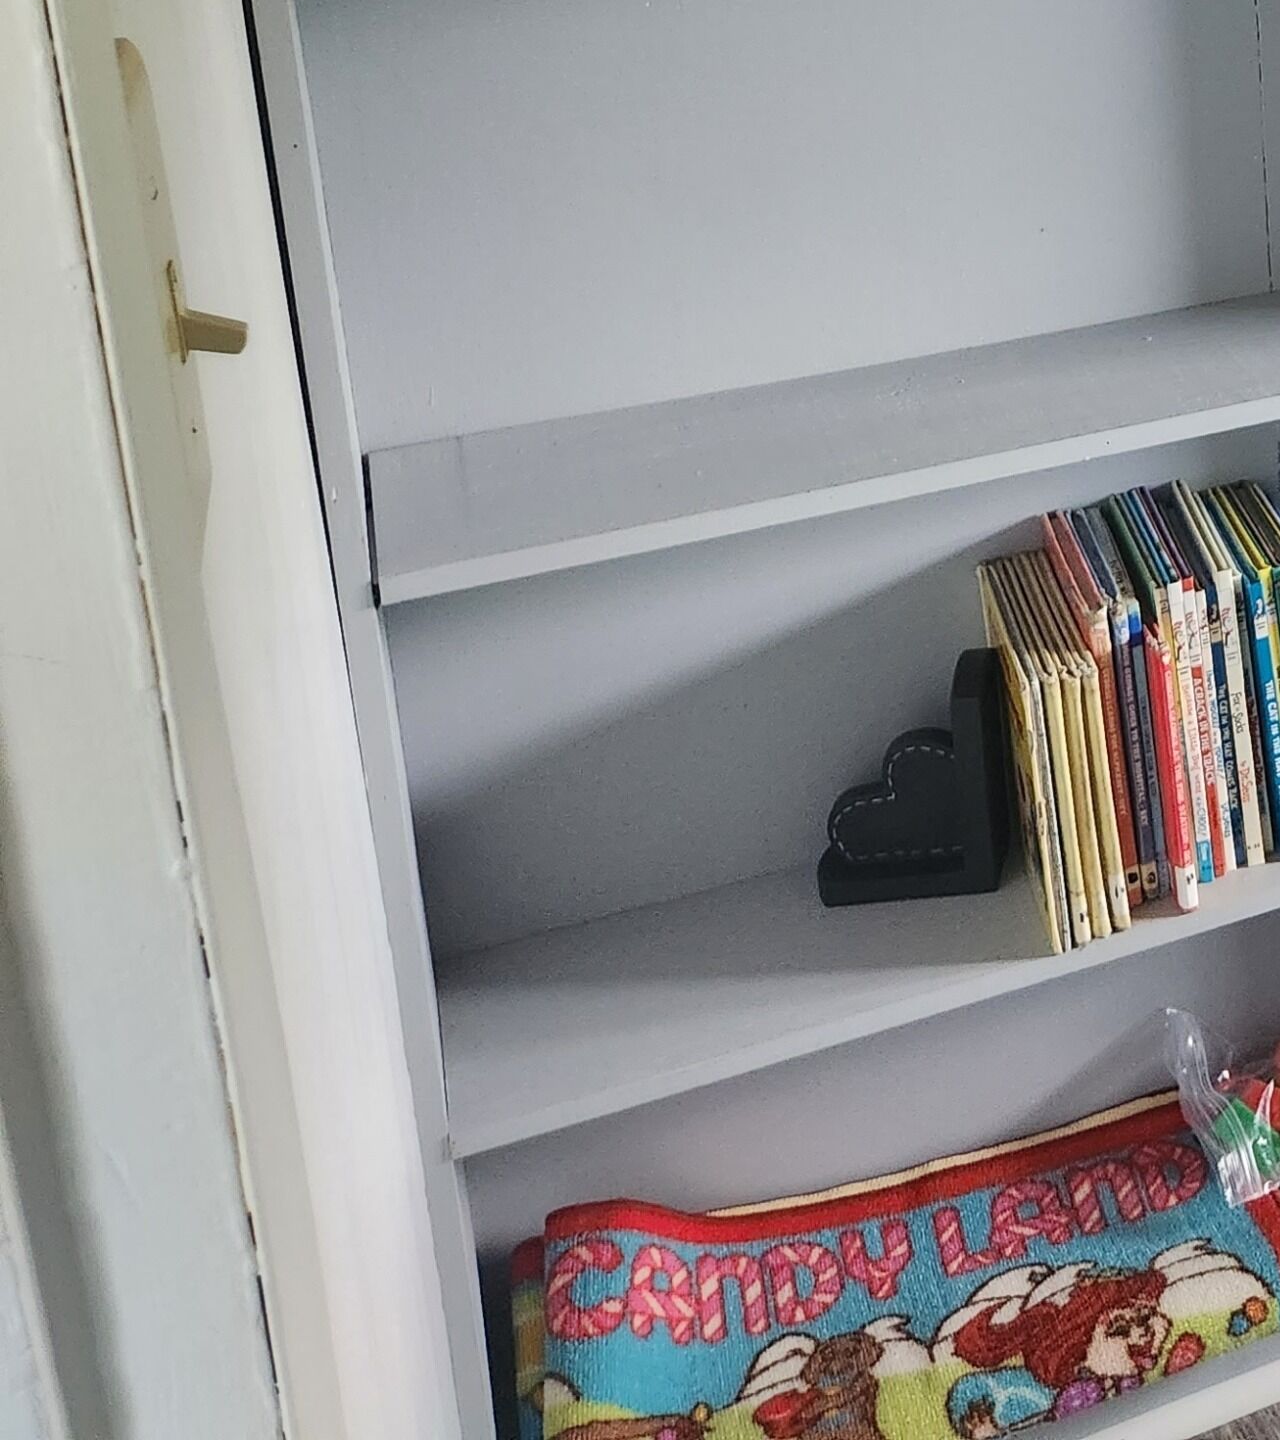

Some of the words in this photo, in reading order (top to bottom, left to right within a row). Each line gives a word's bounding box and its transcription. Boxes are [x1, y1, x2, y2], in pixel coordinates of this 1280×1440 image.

[1193, 677, 1202, 686] A
[1215, 684, 1226, 698] THE
[1263, 679, 1276, 700] THE
[1194, 686, 1207, 720] CRACK
[1217, 699, 1228, 716] CAT
[1230, 691, 1243, 706] Fox
[1266, 701, 1279, 722] CAT
[1198, 719, 1209, 733] IN
[1232, 711, 1246, 734] Socks
[1130, 728, 1138, 741] TO
[1187, 727, 1198, 751] Little
[1200, 733, 1211, 753] THE
[1221, 725, 1230, 741] THE
[1132, 742, 1140, 760] THE
[1222, 740, 1233, 758] HAT
[1271, 737, 1280, 754] THE
[1202, 751, 1216, 786] TRACK
[1224, 759, 1236, 786] COMES
[1134, 760, 1145, 802] HOSPITAL
[1228, 786, 1238, 809] BACK
[546, 1216, 912, 1346] CANDY
[932, 1144, 1202, 1277] LAND
